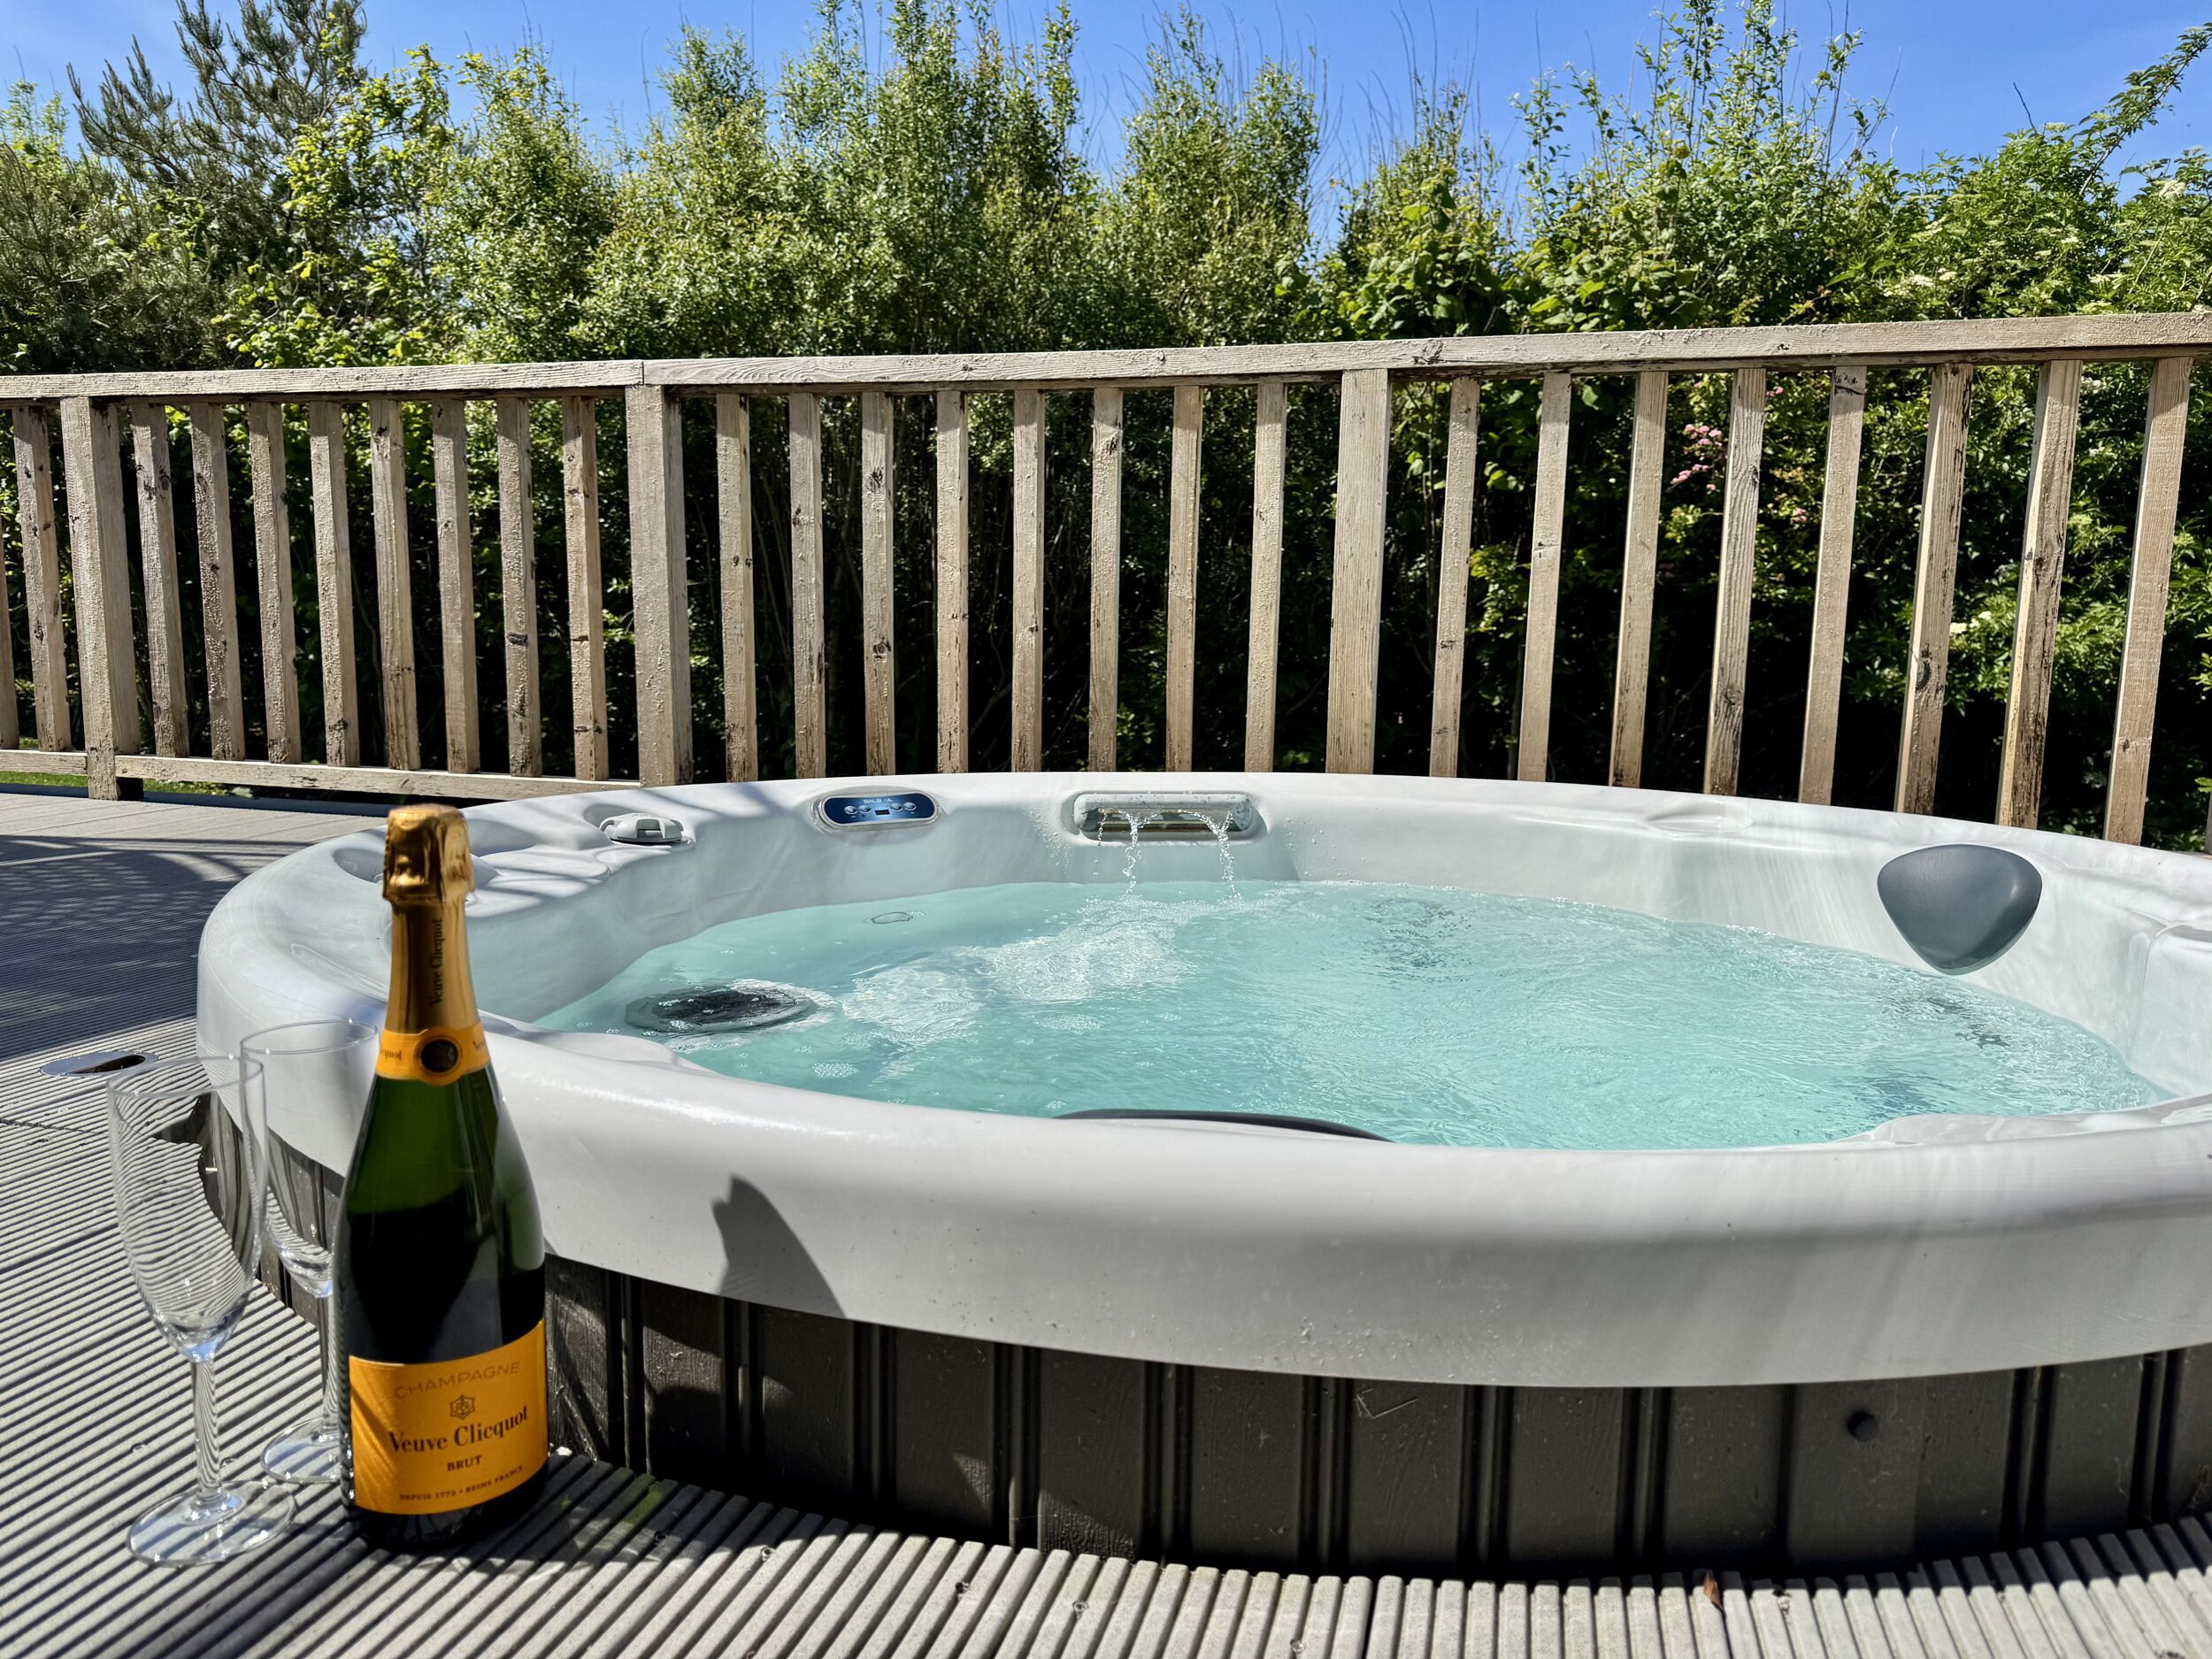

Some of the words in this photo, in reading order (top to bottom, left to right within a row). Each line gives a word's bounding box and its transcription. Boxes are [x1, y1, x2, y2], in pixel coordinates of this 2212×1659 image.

[429, 918, 446, 968] Clicquot
[429, 971, 442, 1006] Veuve
[395, 1361, 520, 1400] CHAMPAGNE
[388, 1431, 448, 1453] Veuve
[453, 1405, 528, 1447] Clicquot
[447, 1455, 482, 1471] BRUT
[494, 1464, 524, 1485] FRANCE
